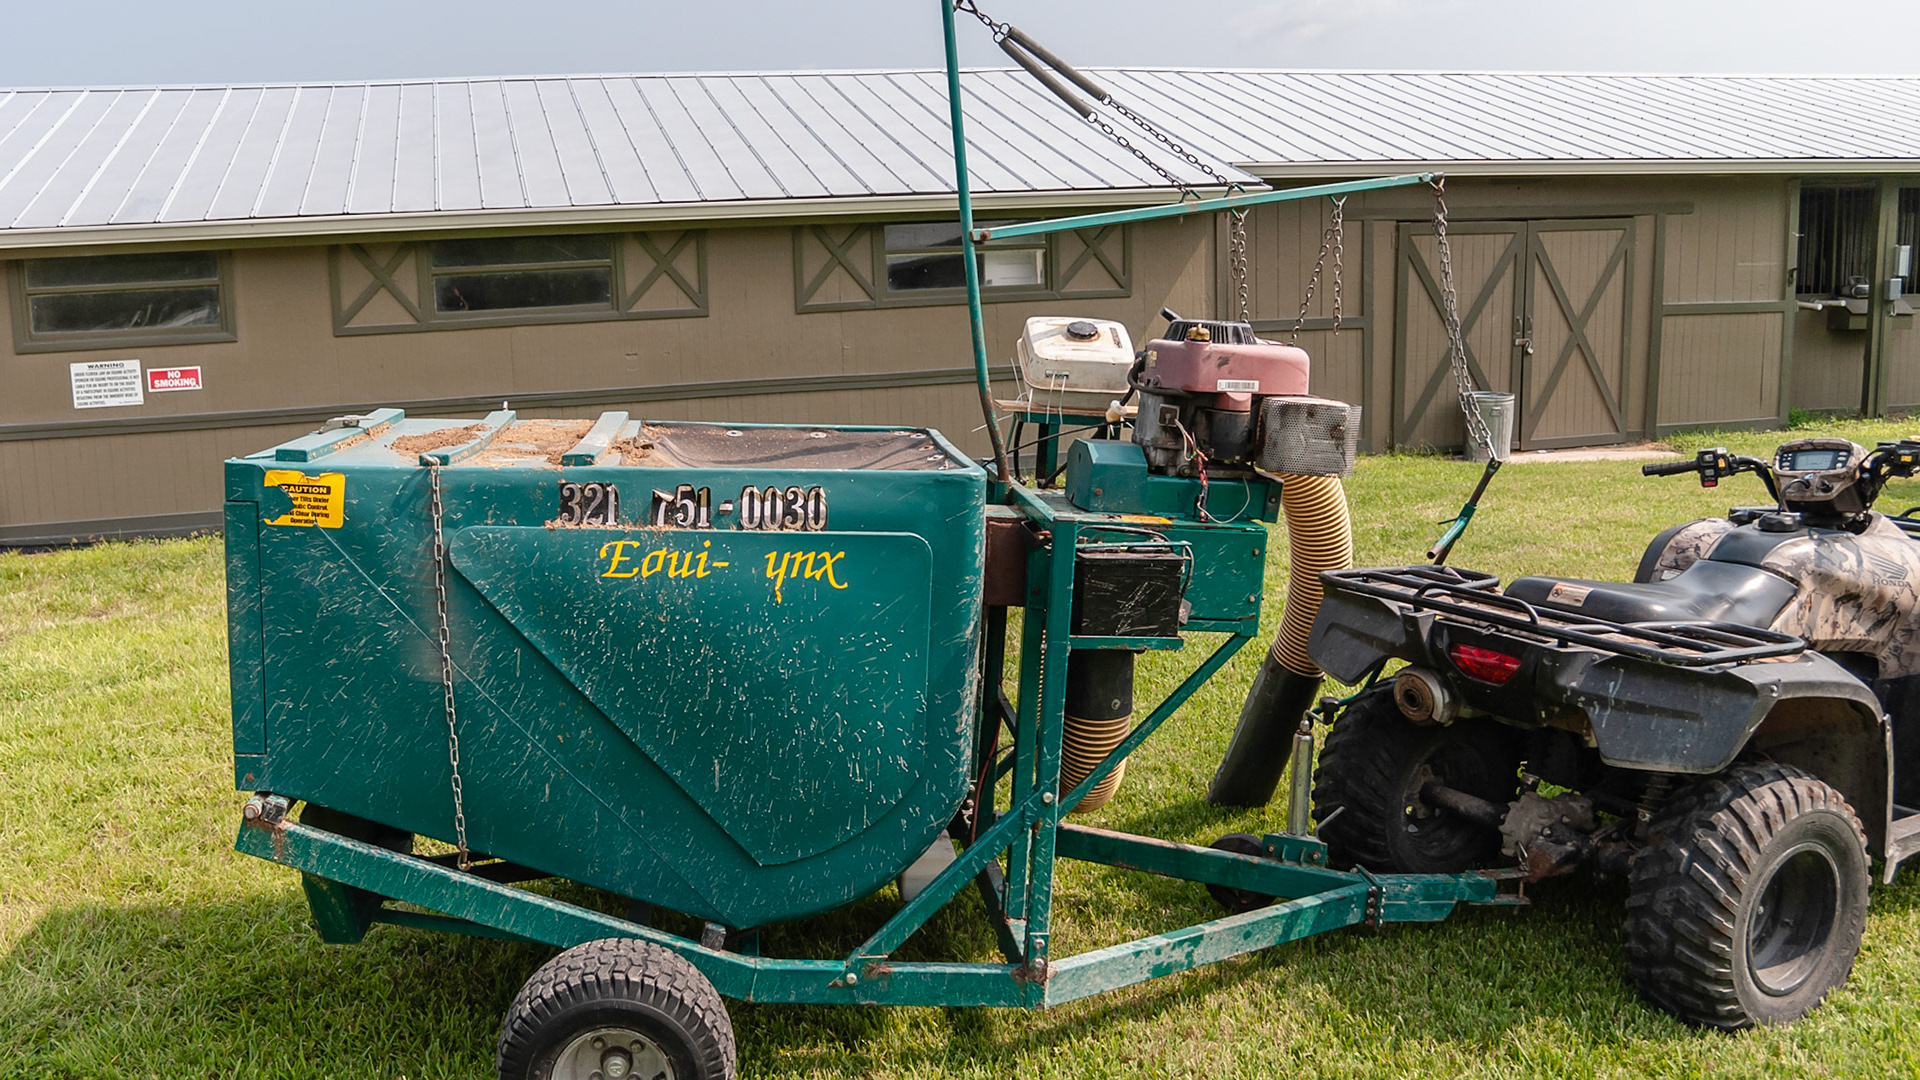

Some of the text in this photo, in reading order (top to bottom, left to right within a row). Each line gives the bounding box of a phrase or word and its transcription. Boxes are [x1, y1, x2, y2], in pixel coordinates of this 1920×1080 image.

[167, 370, 181, 379] NO
[154, 378, 196, 388] SMOKING
[561, 483, 618, 527] 321
[1872, 578, 1912, 588] HONDA
